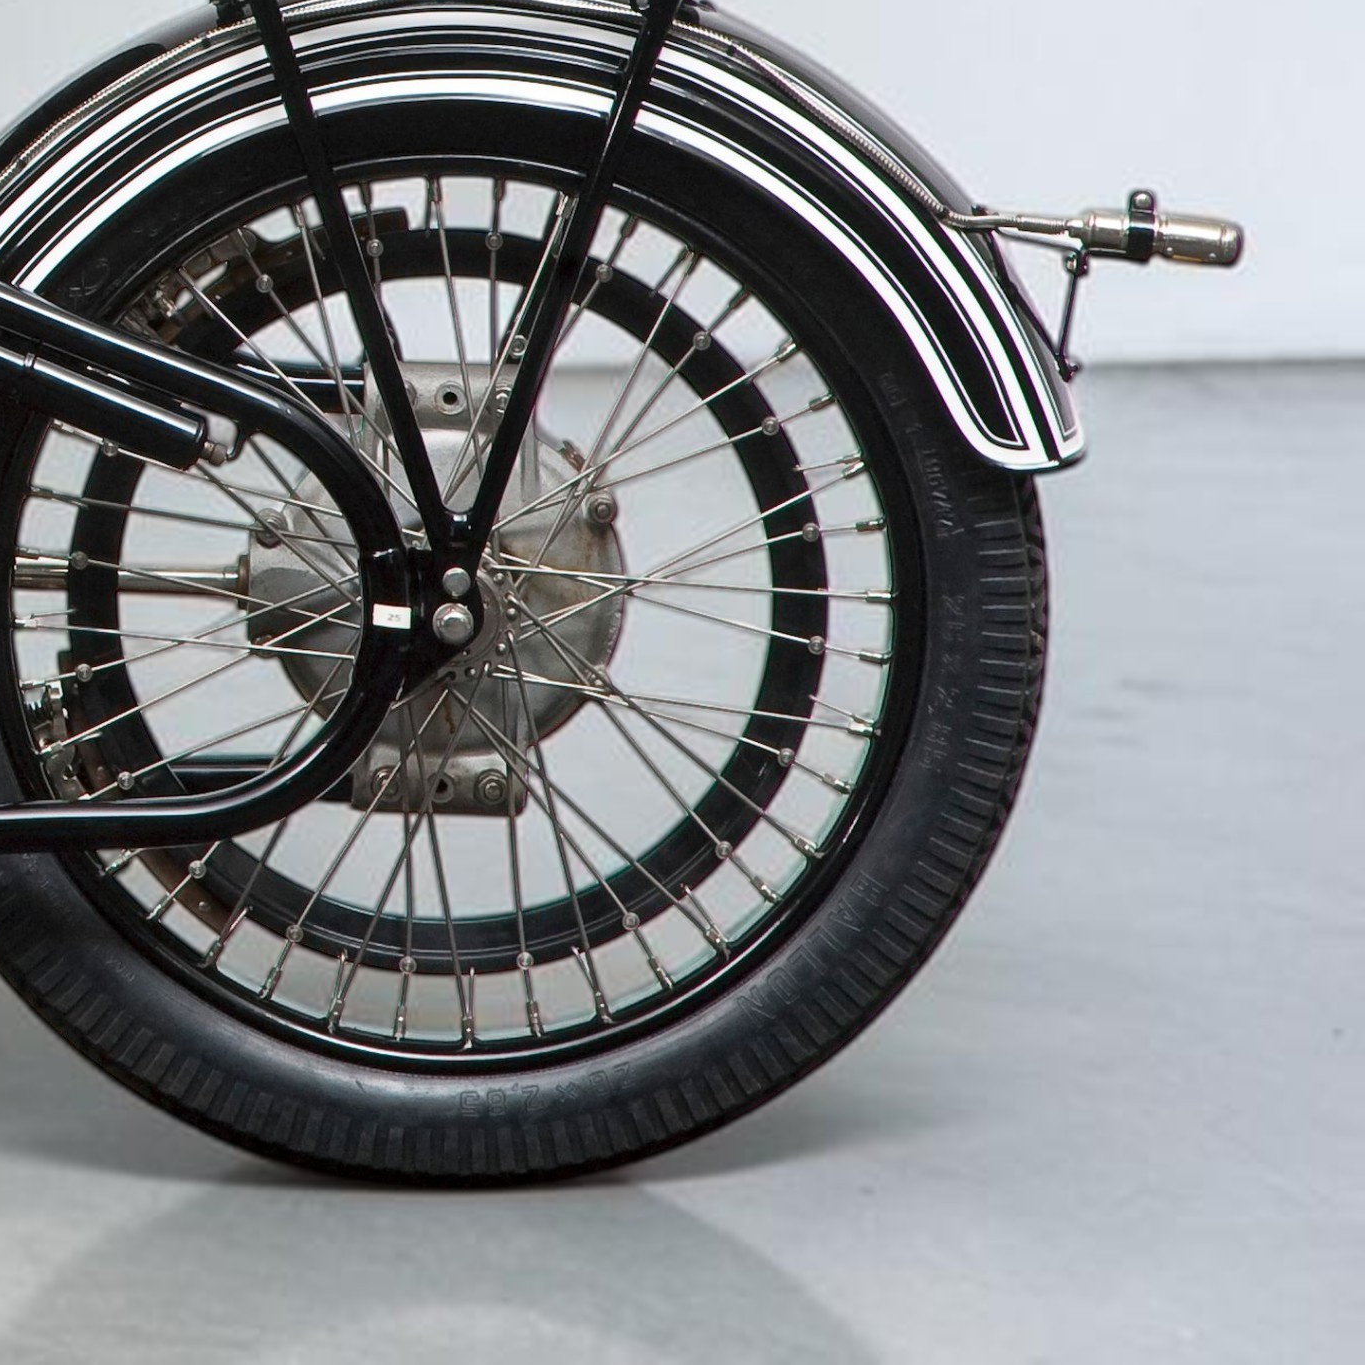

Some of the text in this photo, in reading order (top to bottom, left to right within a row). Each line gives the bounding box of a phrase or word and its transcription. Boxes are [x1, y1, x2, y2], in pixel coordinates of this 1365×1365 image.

[386, 613, 401, 622] 25
[738, 867, 890, 1029] BALLON
[588, 1060, 638, 1098] 26
